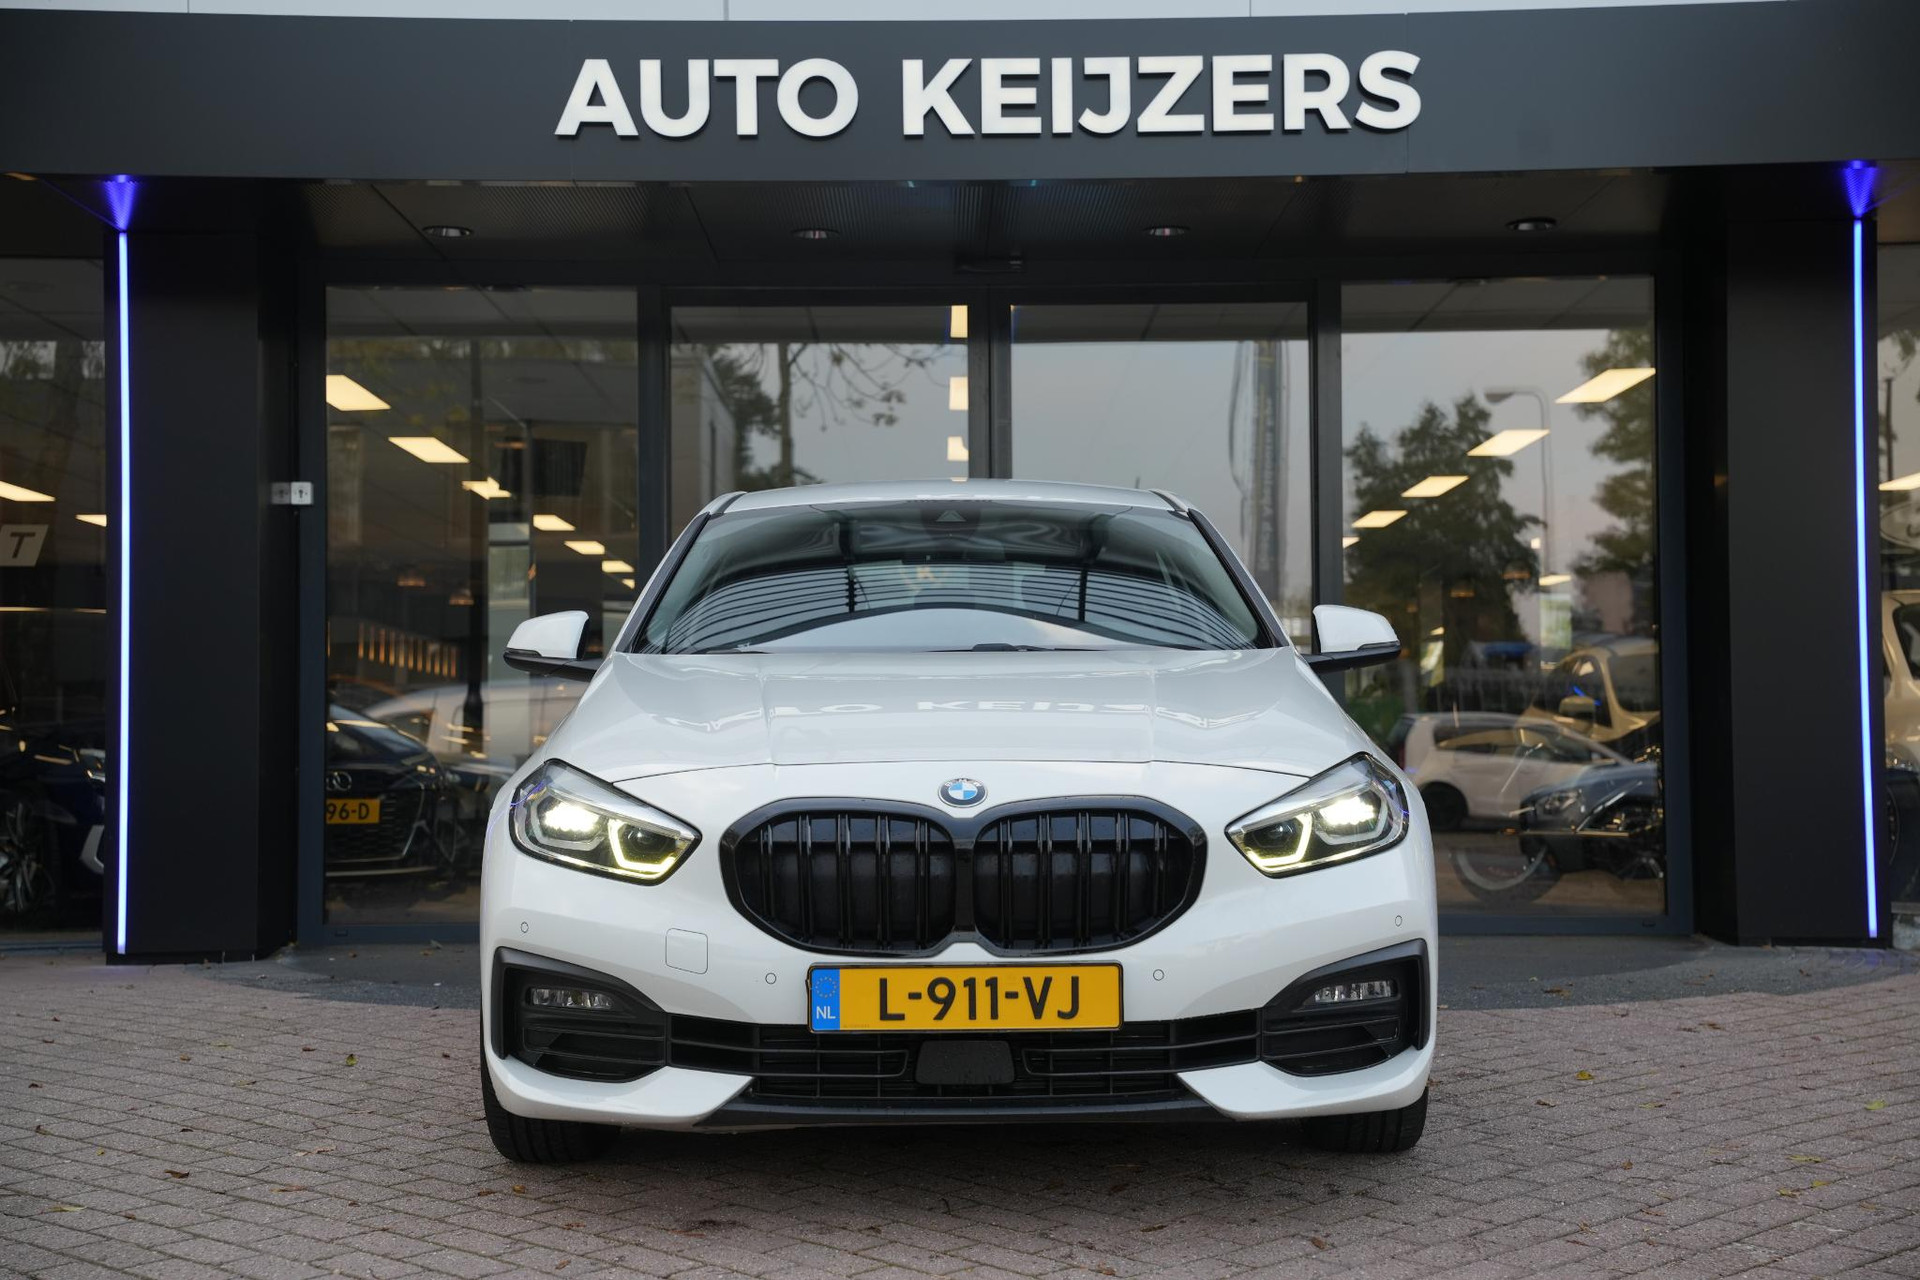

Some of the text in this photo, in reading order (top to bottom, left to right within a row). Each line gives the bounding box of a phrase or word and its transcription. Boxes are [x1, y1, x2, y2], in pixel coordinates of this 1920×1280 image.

[555, 50, 1421, 137] AUTO KEIJZERS
[10, 531, 36, 559] T
[815, 975, 1080, 1022] NL L-911-VJ
